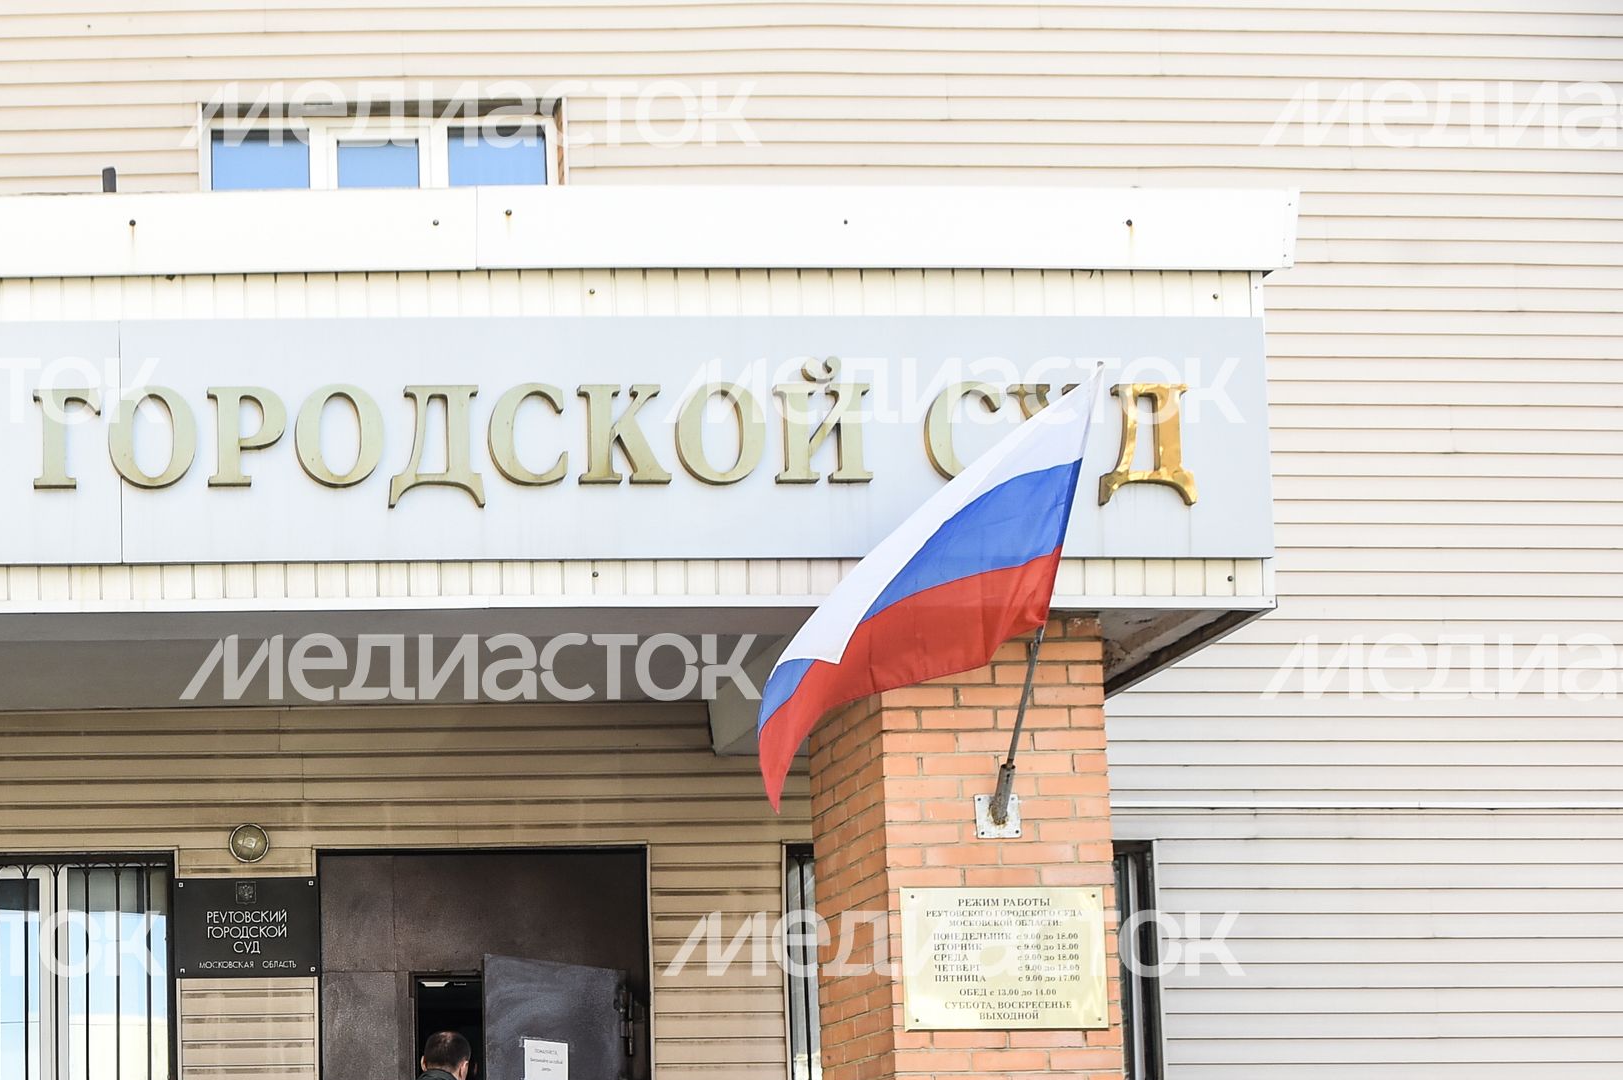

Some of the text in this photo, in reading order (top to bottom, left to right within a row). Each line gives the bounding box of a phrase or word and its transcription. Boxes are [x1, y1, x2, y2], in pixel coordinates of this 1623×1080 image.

[33, 356, 874, 508] ГОРОДСКОЙ
[923, 380, 1197, 507] СД
[958, 898, 1050, 907] РЕЖИМ РАБОТЫ
[206, 909, 287, 924] РЕУТОВСКИЙ
[926, 910, 992, 918] РЕУТОВСКОГО
[207, 924, 287, 939] ГОРОДСКОЙ
[233, 941, 260, 954] СУД
[934, 943, 982, 951] ВТОРНИК
[199, 960, 296, 969] МОСКОВСКАЯ ОБЛАСТЬ
[959, 989, 987, 997] ОБЕД
[998, 1001, 1072, 1009] ВОСКРЕСЕНЬЕ
[979, 1010, 1039, 1020] ВЫХОДНОЙ
